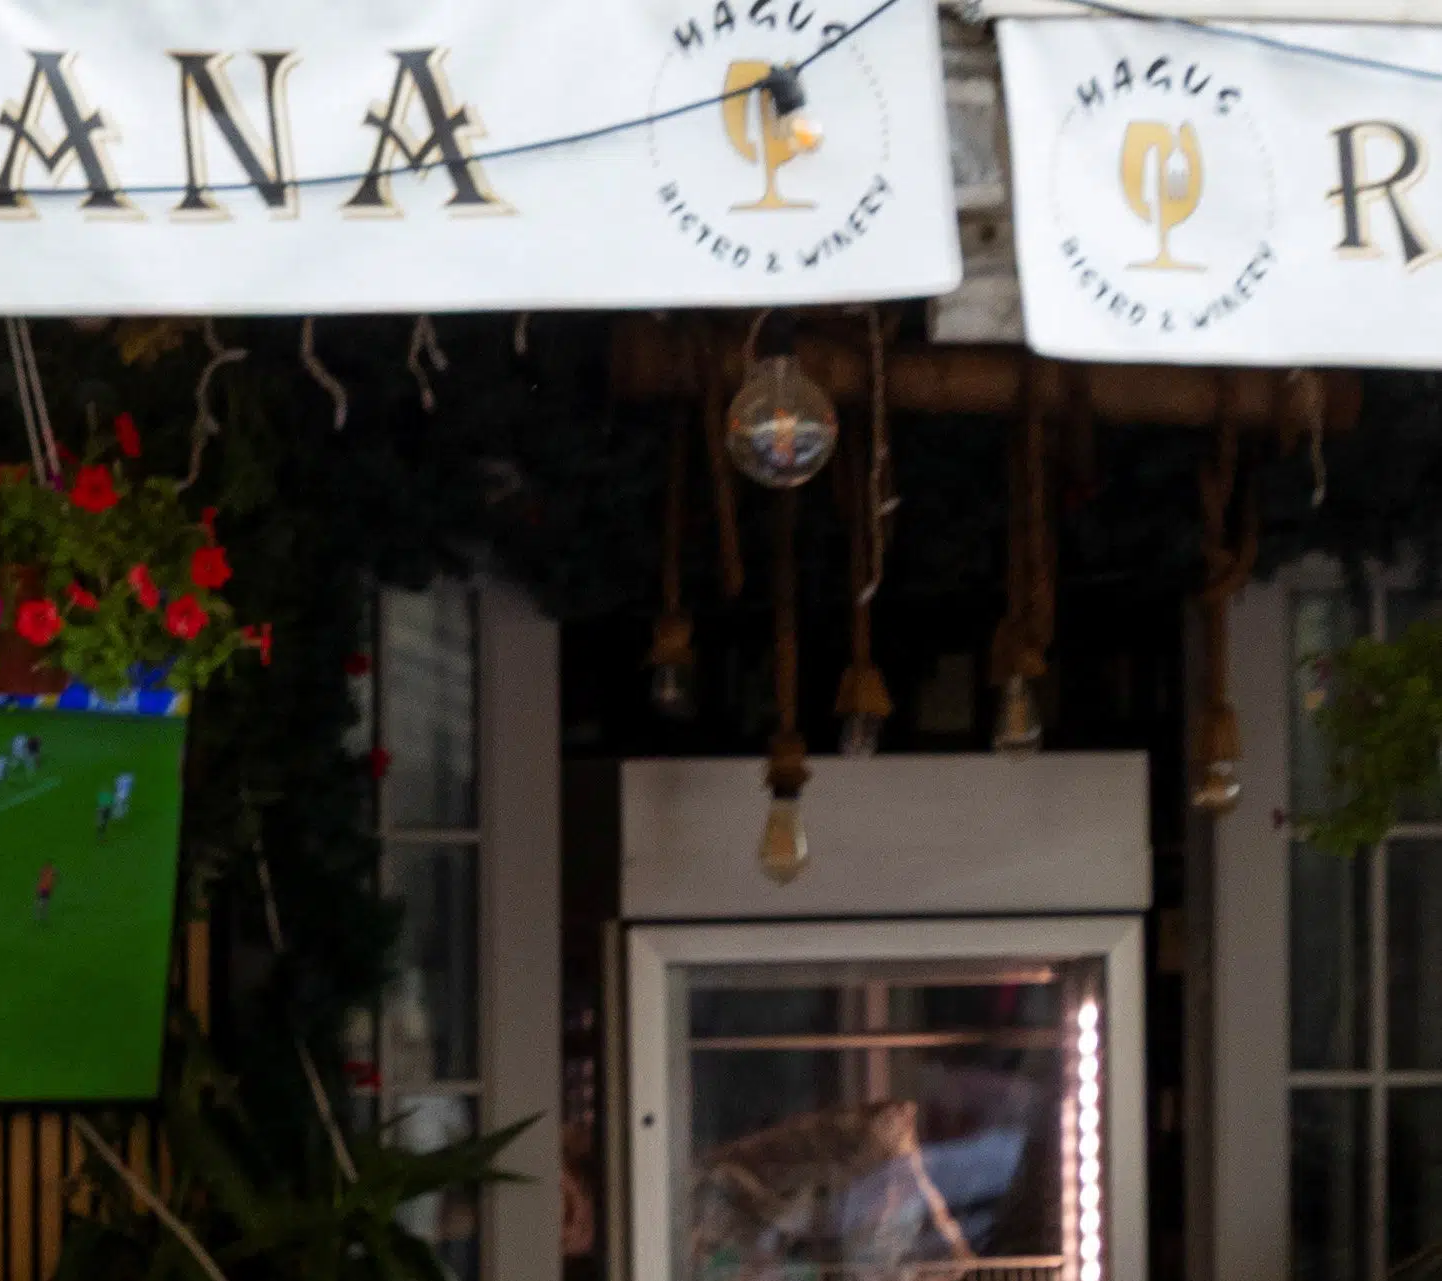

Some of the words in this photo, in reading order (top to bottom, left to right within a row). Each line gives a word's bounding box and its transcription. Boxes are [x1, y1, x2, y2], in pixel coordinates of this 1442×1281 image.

[1076, 54, 1243, 114] MAGUS
[656, 180, 752, 268] BISTRO
[800, 172, 893, 268] WINERY
[1060, 234, 1148, 326] BISTRO
